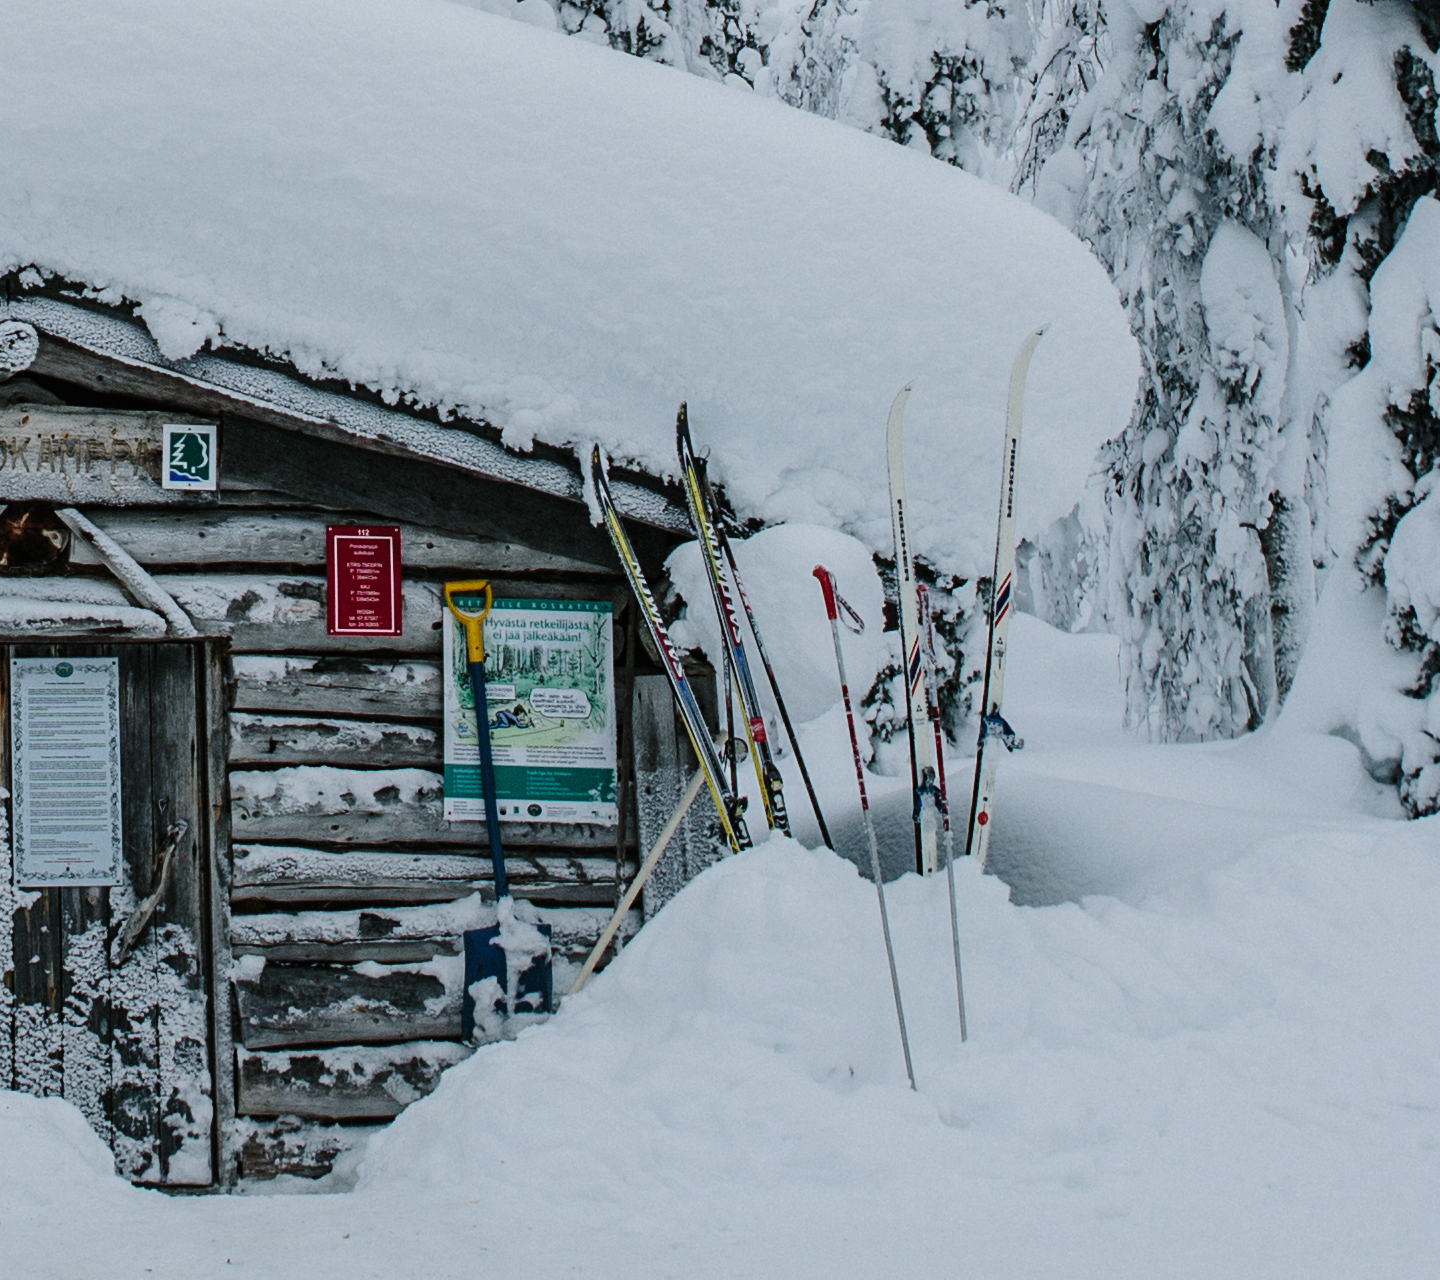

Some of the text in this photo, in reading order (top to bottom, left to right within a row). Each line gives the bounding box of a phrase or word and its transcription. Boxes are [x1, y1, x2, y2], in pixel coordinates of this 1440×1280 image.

[357, 528, 370, 536] 112
[704, 521, 741, 643] SALOMON
[459, 599, 600, 611] RETEILE ROSKATTA
[485, 616, 526, 630] Hyvästä
[631, 561, 684, 678] SALOMON
[492, 629, 582, 643] ei jää jälkeäkään!
